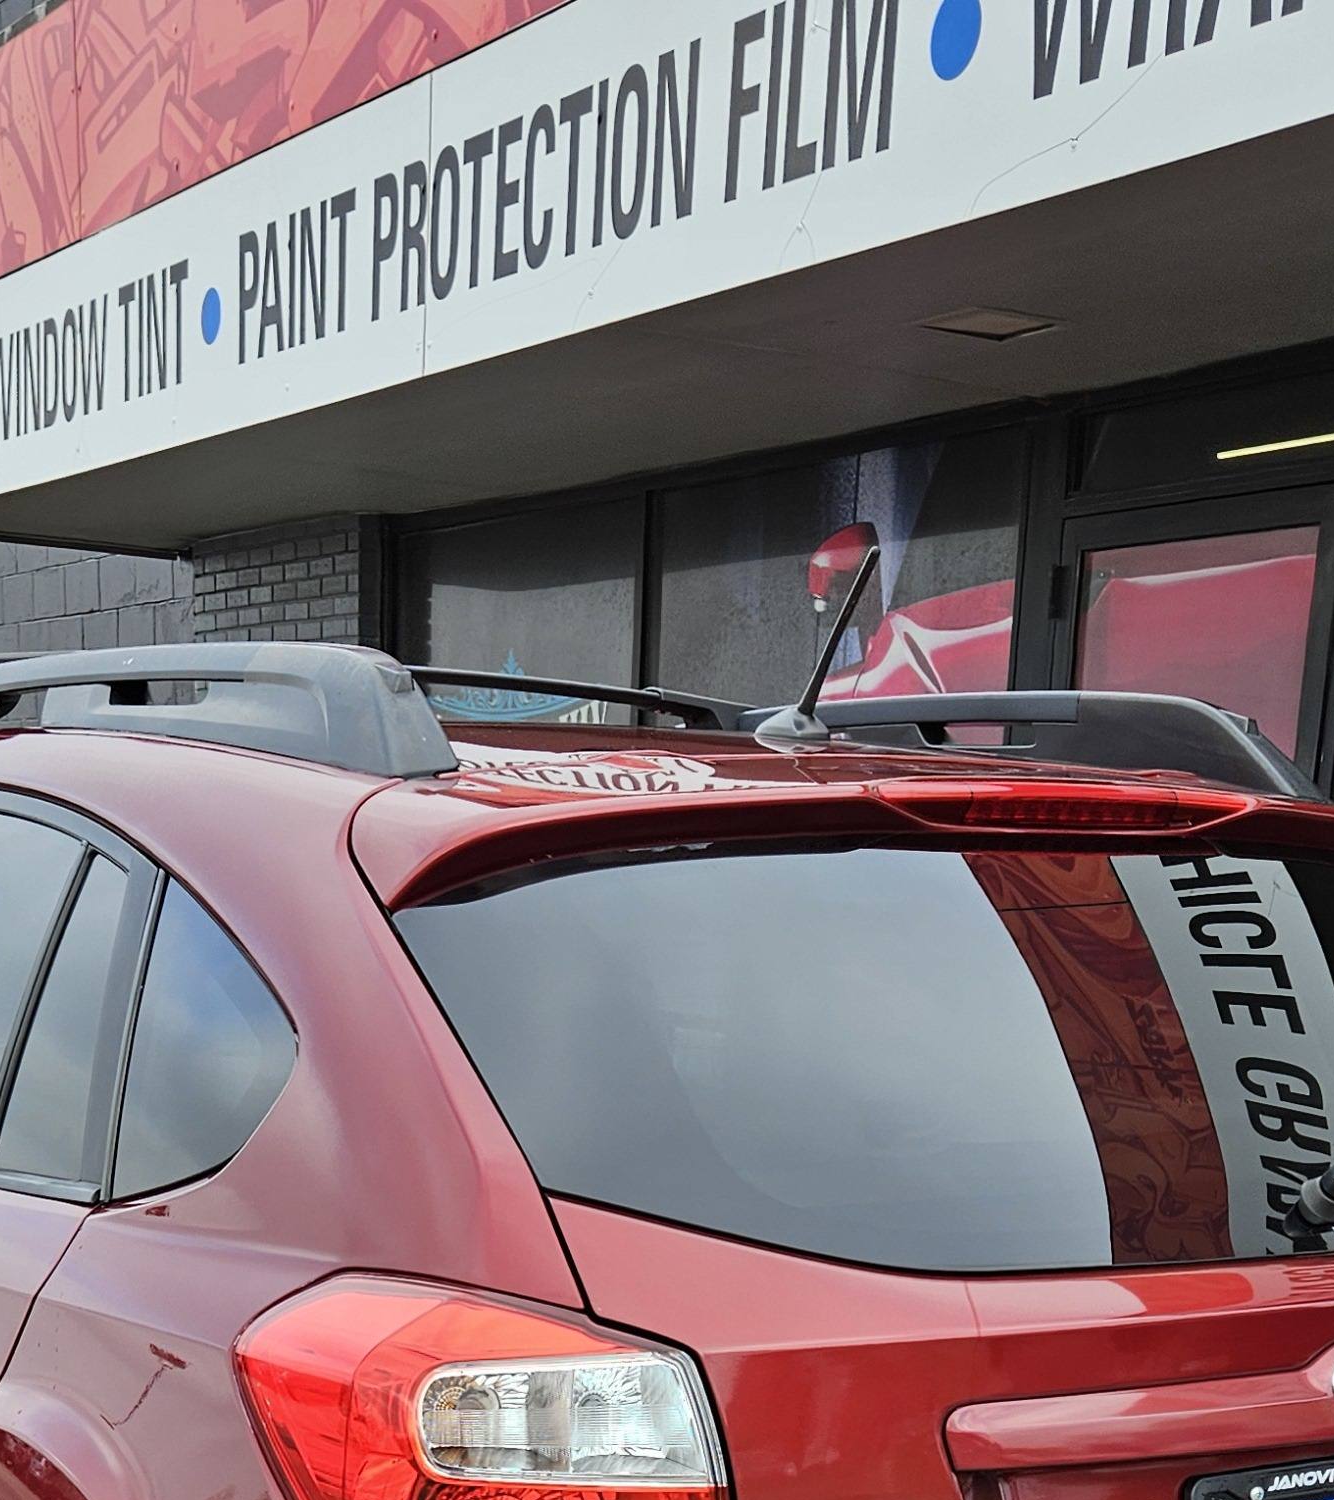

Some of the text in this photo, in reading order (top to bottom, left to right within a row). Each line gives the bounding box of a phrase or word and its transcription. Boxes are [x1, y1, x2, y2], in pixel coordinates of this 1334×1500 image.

[118, 260, 189, 403] TINT
[238, 188, 356, 364] PAINT
[371, 37, 701, 322] PROTECTION
[724, 0, 897, 203] FILM
